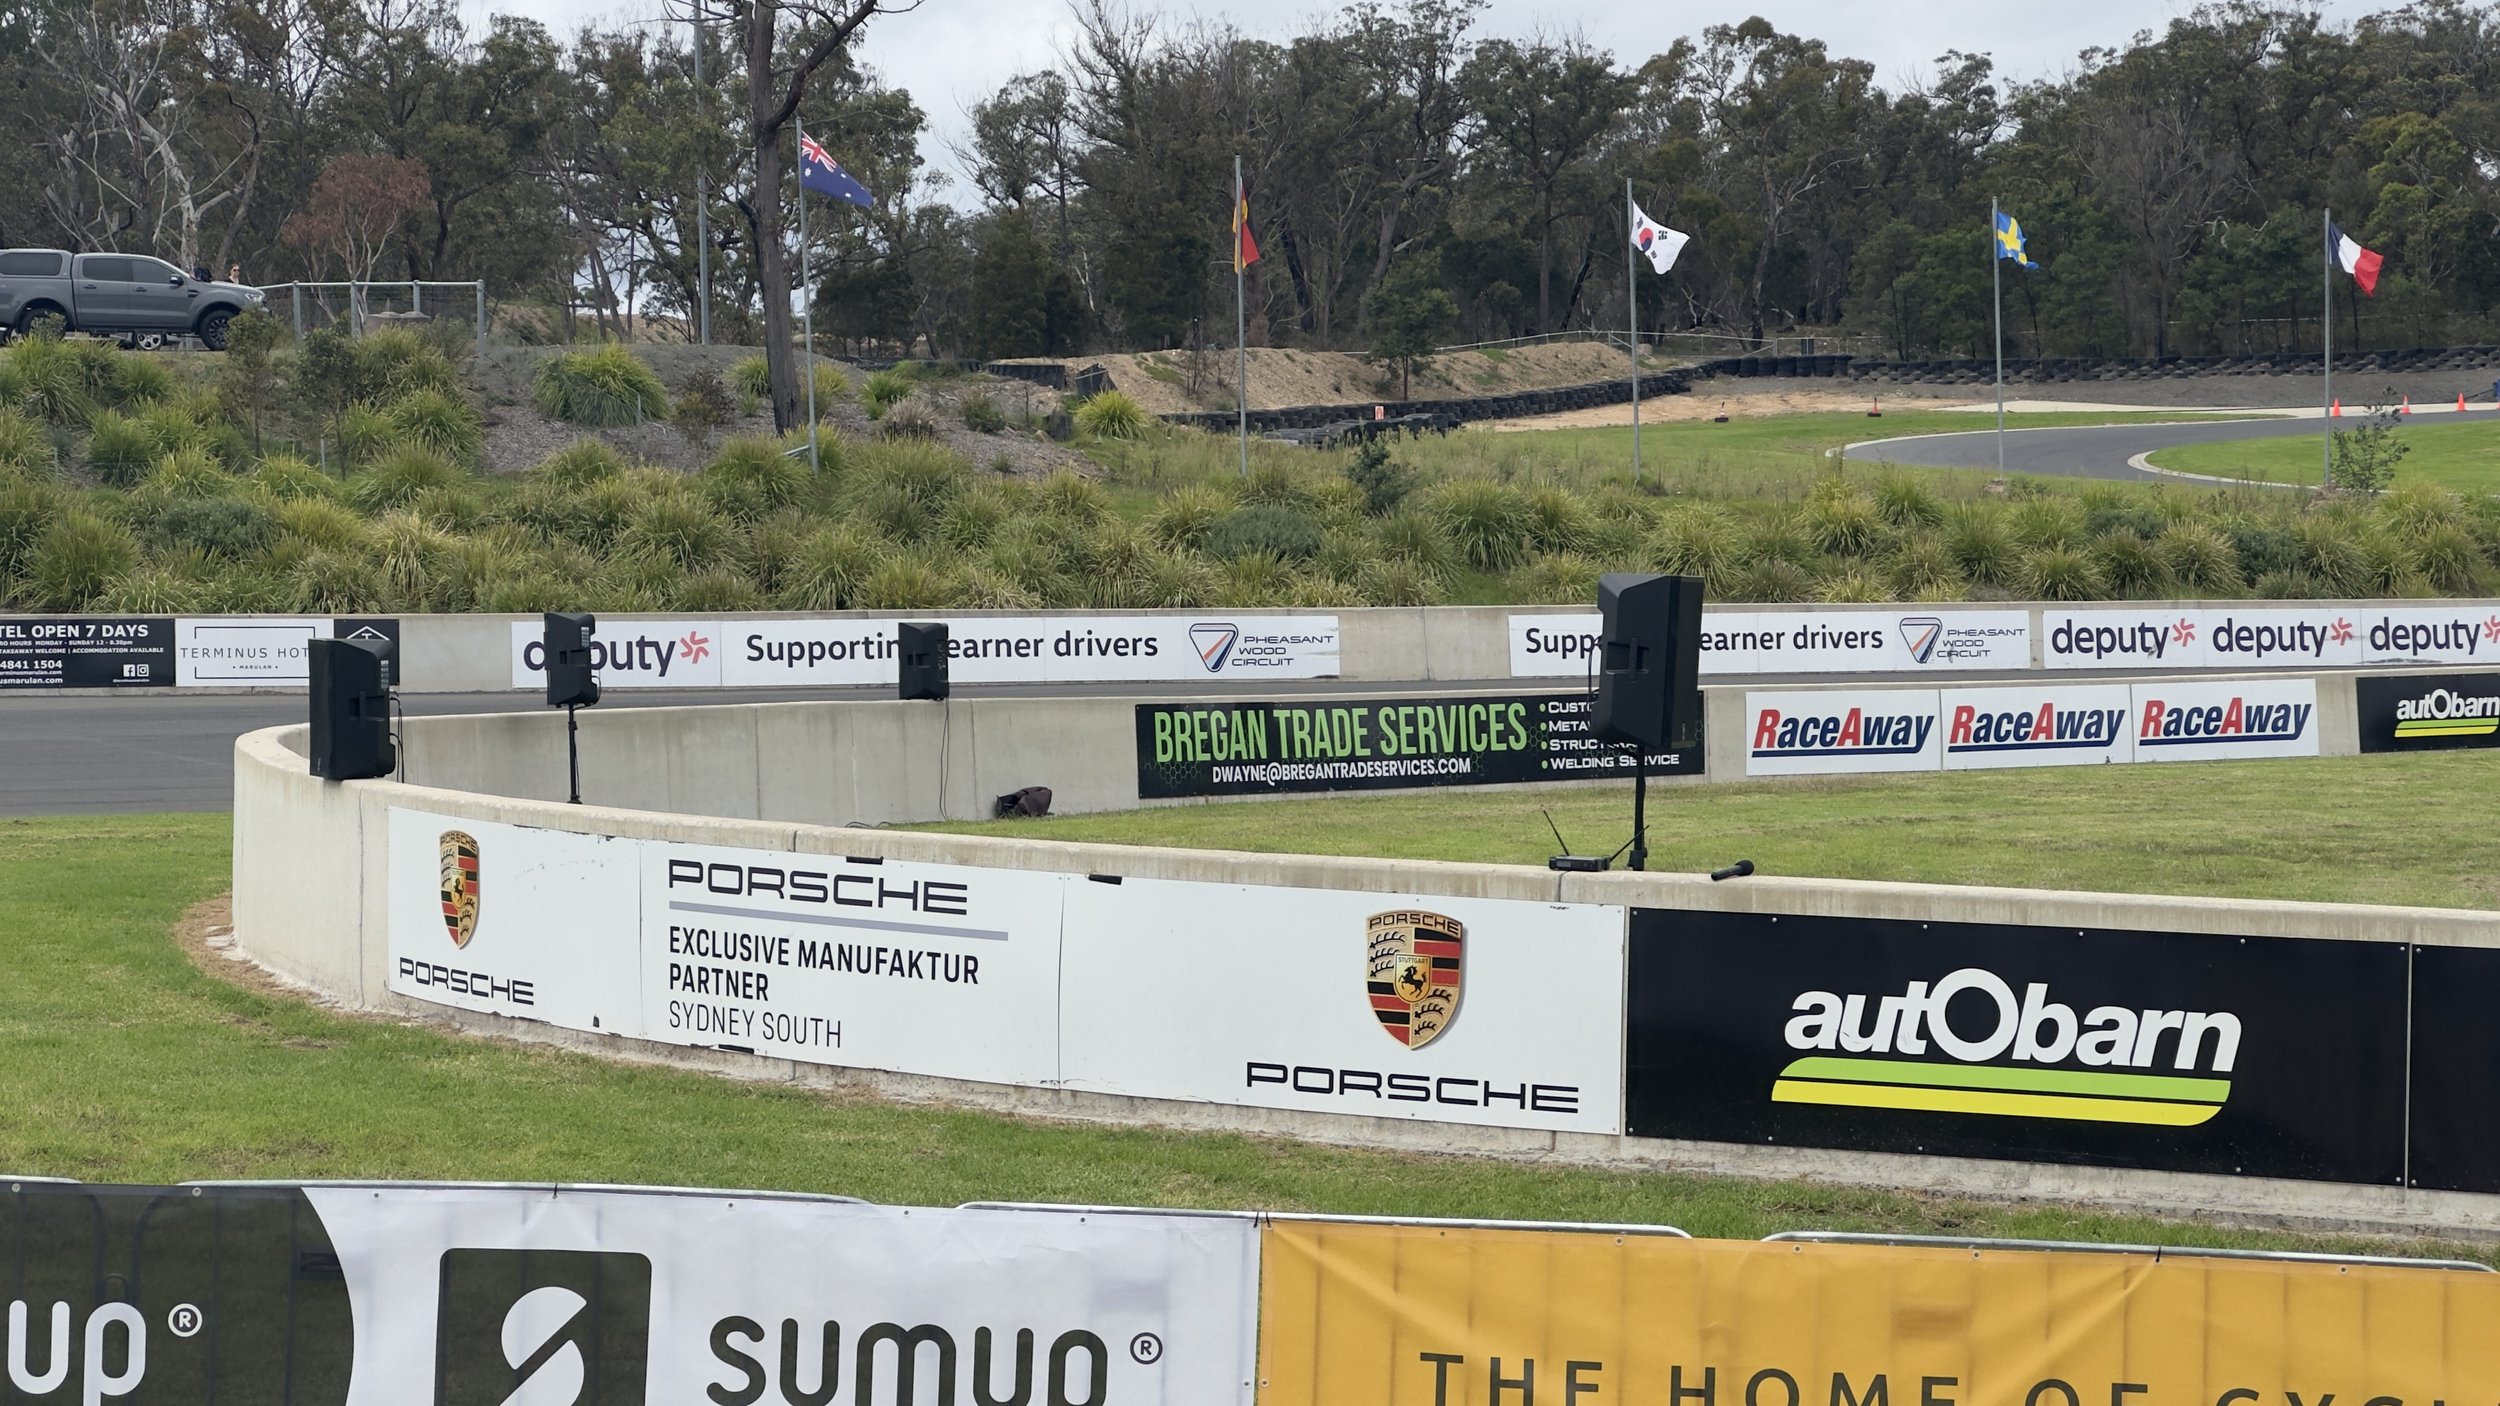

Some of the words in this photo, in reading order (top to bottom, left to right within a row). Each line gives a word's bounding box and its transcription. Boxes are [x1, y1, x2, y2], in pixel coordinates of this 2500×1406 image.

[31, 625, 79, 638] OPEN
[86, 625, 96, 637] 7
[102, 625, 149, 637] DAYS
[747, 632, 900, 668] Supportin
[947, 636, 1044, 658] earner
[1054, 630, 1158, 656] drivers
[1244, 635, 1334, 644] PHEASANT
[1701, 631, 1785, 651] earner
[1793, 624, 1883, 649] drivers
[1947, 629, 2025, 637] PHEASANT
[2051, 619, 2169, 659] deputy
[2213, 618, 2327, 657] deputy
[2370, 616, 2480, 656] deputy
[34, 660, 63, 669] 1504
[181, 647, 268, 658] TERMINUS
[278, 647, 309, 658] HOT
[1232, 658, 1294, 666] CIRCUIT
[1239, 647, 1286, 655] WOOD
[1937, 650, 1991, 658] CIRCUIT
[1154, 709, 1268, 763] BREGAN
[1273, 708, 1371, 759] TRADE
[1378, 702, 1528, 756] SERVICES
[1549, 721, 1591, 732] META
[1753, 708, 1934, 753] RaceAway
[1948, 702, 2125, 748] RaceAway
[2140, 697, 2311, 741] RaceAway
[1212, 757, 1471, 786] DWAYNE@BREGANTRADESERVICES.COM
[1551, 756, 1614, 769] WELDING
[669, 859, 967, 915] PORSCHE
[1369, 913, 1459, 936] PORSCHE
[669, 925, 789, 967] EXCLUSIVE
[798, 940, 979, 985] MANUFAKTUR
[399, 957, 534, 1006] PORSCHE
[669, 967, 769, 1001] PARTNER
[669, 1000, 755, 1038] SYDNEY
[763, 1013, 842, 1048] SOUTH
[1784, 968, 2242, 1073] autObarn
[1247, 1062, 1579, 1113] PORSCHE
